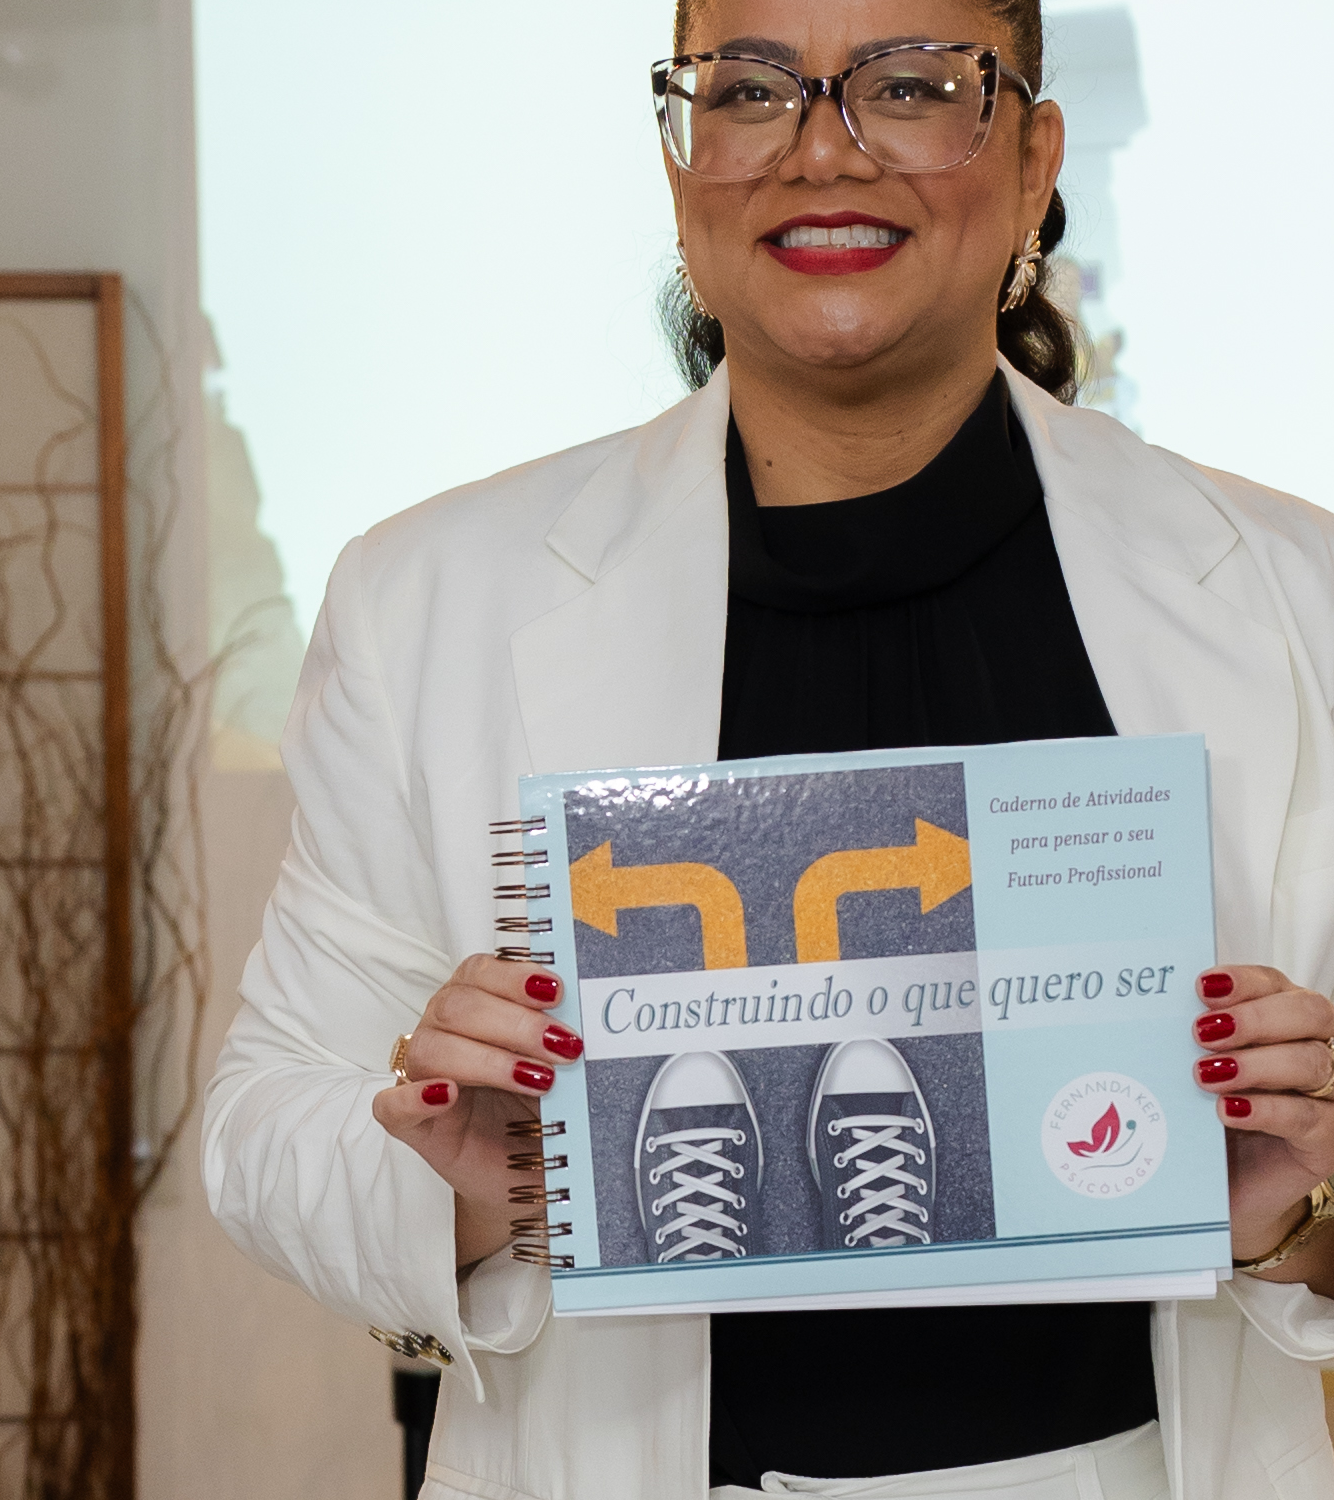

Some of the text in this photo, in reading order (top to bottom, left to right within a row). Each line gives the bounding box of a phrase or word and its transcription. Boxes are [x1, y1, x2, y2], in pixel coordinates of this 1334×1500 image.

[989, 785, 1171, 814] Caderno de Atividades
[1010, 828, 1155, 855] para pensar o seu
[1007, 860, 1163, 889] Futuro Profissional
[600, 964, 1175, 1035] Construindo o que quero ser
[1050, 1079, 1161, 1131] FERNANDA KER
